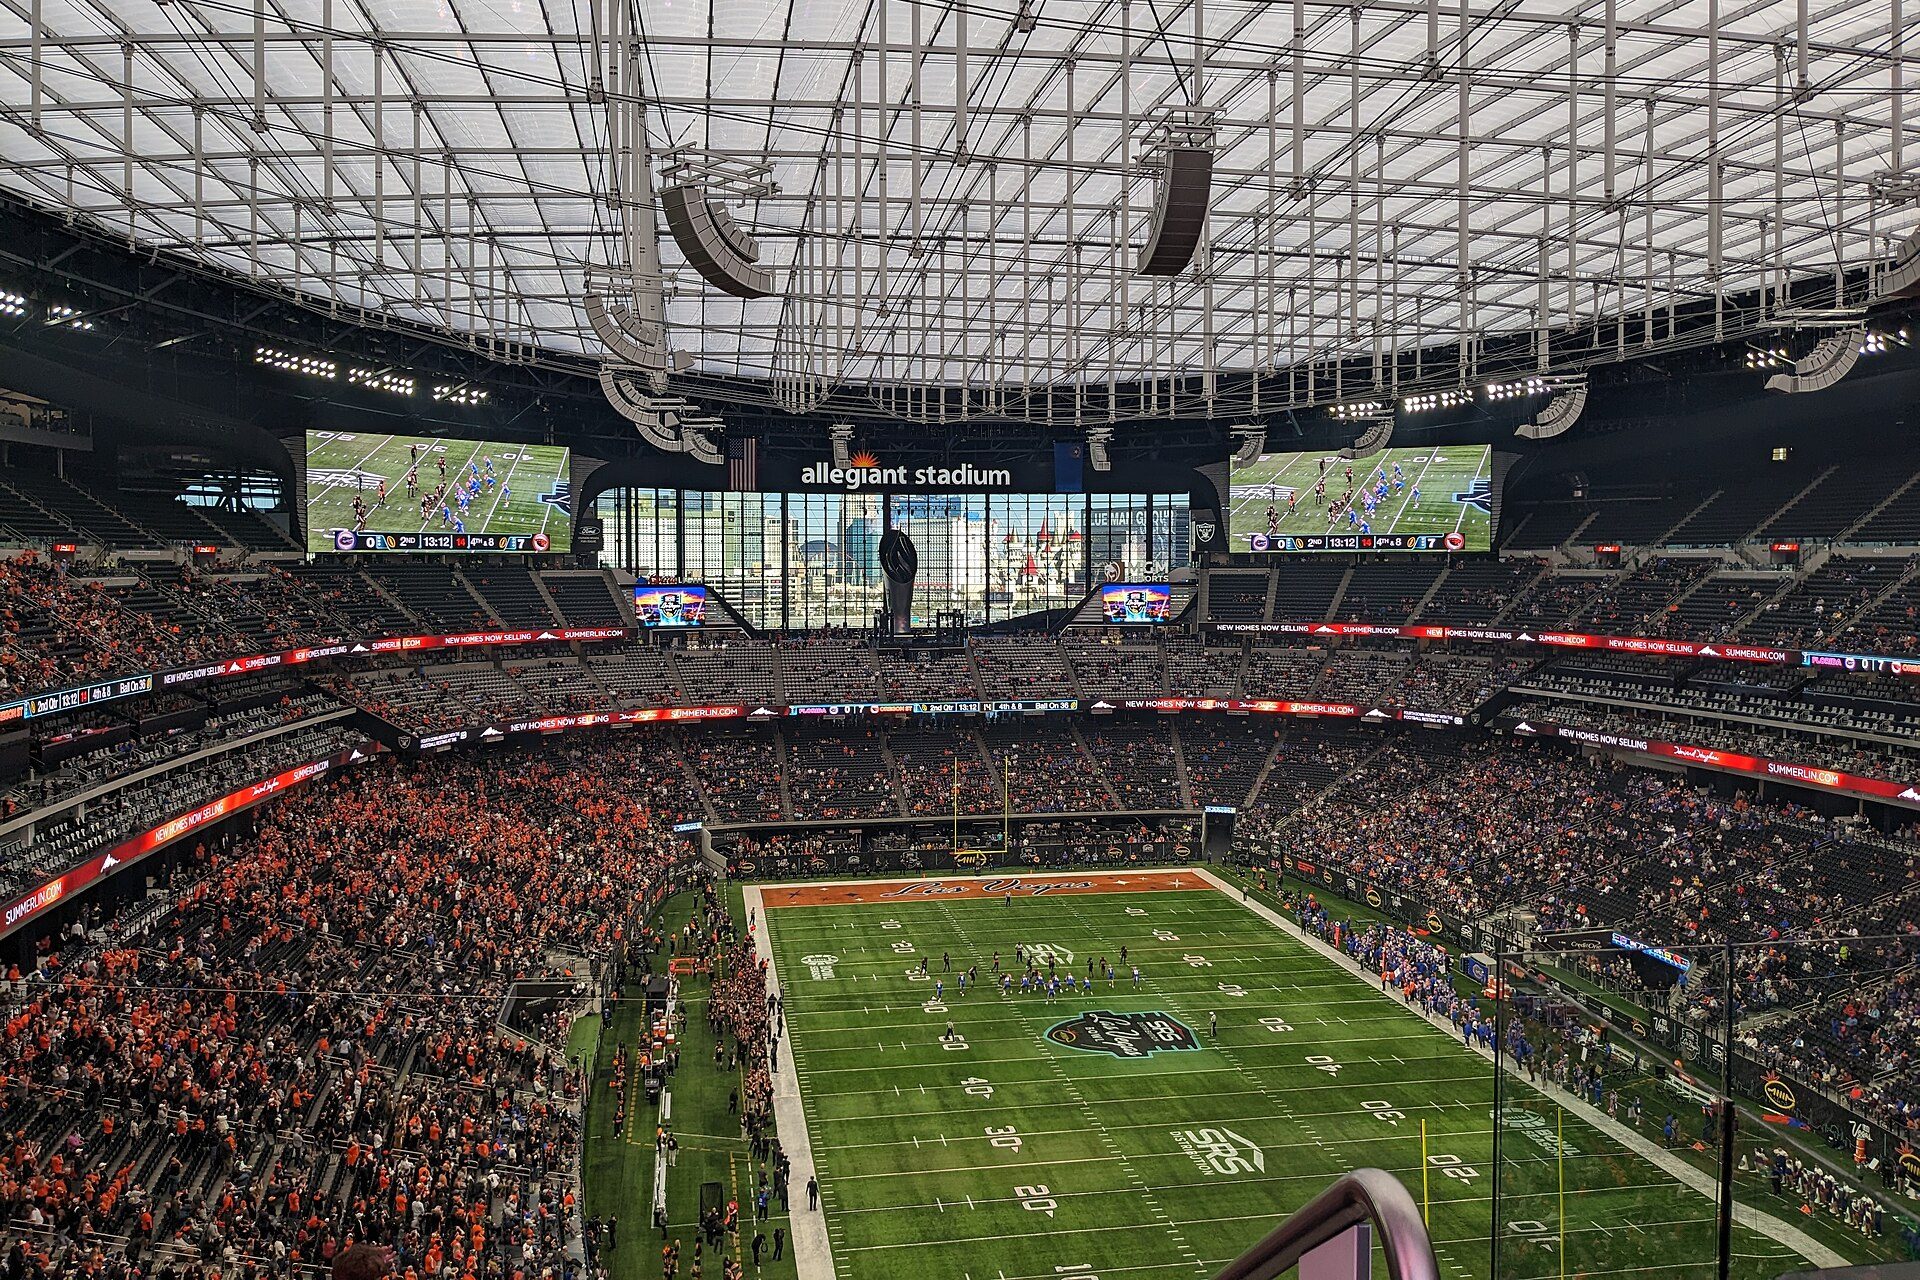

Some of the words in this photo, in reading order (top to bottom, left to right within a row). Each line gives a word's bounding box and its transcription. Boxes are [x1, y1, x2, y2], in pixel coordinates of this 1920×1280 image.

[801, 461, 907, 490] allegiant
[915, 462, 1011, 486] stadium
[366, 537, 376, 549] 0
[399, 537, 416, 547] 2ND
[424, 536, 450, 548] 13:12
[470, 537, 483, 546] 4TH
[488, 537, 495, 546] 8
[518, 538, 525, 549] 7
[1277, 539, 1286, 549] 0
[1307, 538, 1322, 548] 2ND
[1330, 538, 1355, 548] 13:12
[1376, 538, 1390, 546] 4TH
[1395, 538, 1402, 546] 8
[1428, 539, 1436, 548] 7
[1128, 561, 1169, 574] MGM
[445, 636, 460, 644] NEW
[460, 635, 484, 643] HOMES
[484, 634, 502, 642] NOW
[503, 633, 532, 641] SELLING
[564, 629, 623, 639] SUMMERLIN.COM
[1343, 626, 1399, 634] SUMMERLIN.COM
[1445, 629, 1467, 637] HOMES
[1485, 631, 1512, 640] SELLING
[1538, 635, 1586, 644] SUMMERLIN.COM
[295, 651, 306, 660] NEW
[306, 649, 319, 659] HOMES
[319, 648, 330, 657] NOW
[330, 646, 347, 655] SELLING
[371, 639, 421, 650] SUMMERLIN.COM
[1609, 639, 1624, 647] NEW
[1624, 641, 1647, 649] HOMES
[1647, 642, 1664, 650] NOW
[1665, 643, 1693, 653] SELLING
[1725, 648, 1785, 661] SUMMERLIN.COM
[164, 674, 177, 684] NEW
[176, 670, 193, 681] HOMES
[194, 668, 207, 678] NOW
[206, 665, 226, 676] SELLING
[245, 656, 281, 669] SUMMERLIN.COM
[1861, 659, 1869, 669] 0
[1878, 660, 1884, 671] 7
[37, 702, 48, 713] 2nd
[49, 699, 59, 709] Qtr
[62, 692, 78, 706] 13:12
[92, 688, 102, 699] 4th
[102, 687, 107, 698] &
[107, 686, 111, 696] 8
[120, 681, 130, 693] Ball
[131, 680, 139, 691] On
[139, 679, 146, 690] 36
[844, 705, 851, 713] 0
[859, 705, 865, 713] 7
[1290, 704, 1354, 714] SUMMERLIN.COM
[510, 723, 527, 732] NEW
[528, 721, 556, 730] HOMES
[557, 719, 575, 727] NOW
[577, 715, 609, 725] SELLING
[671, 708, 737, 718] SUMMERLIN.COM
[1558, 728, 1574, 738] NEW
[1575, 730, 1599, 742] HOMES
[1600, 734, 1617, 745] NOW
[1619, 738, 1648, 750] SELLING
[1767, 762, 1839, 784] SUMMERLIN.COM
[155, 827, 169, 842] NEW
[169, 817, 188, 834] HOMES
[188, 810, 203, 826] NOW
[203, 802, 224, 819] SELLING
[293, 760, 329, 781] SUMMERLIN.COM
[879, 881, 971, 898] Las
[974, 878, 1098, 896] Vegas
[5, 881, 62, 925] SUMMERLIN.COM
[1089, 1013, 1132, 1031] Las
[1145, 1020, 1183, 1042] SRS
[1257, 1017, 1295, 1033] 50
[1085, 1026, 1105, 1043] BOWL
[1101, 1029, 1143, 1057] Vegas
[1304, 1055, 1343, 1073] 40
[960, 1076, 995, 1095] 40
[1360, 1100, 1406, 1121] 30
[984, 1125, 1023, 1148] 30
[1169, 1130, 1216, 1176] DISTRIBUTION
[1184, 1128, 1256, 1175] SRS
[1426, 1154, 1480, 1178] 20
[1013, 1183, 1059, 1211] 20
[1507, 1220, 1561, 1243] 10
